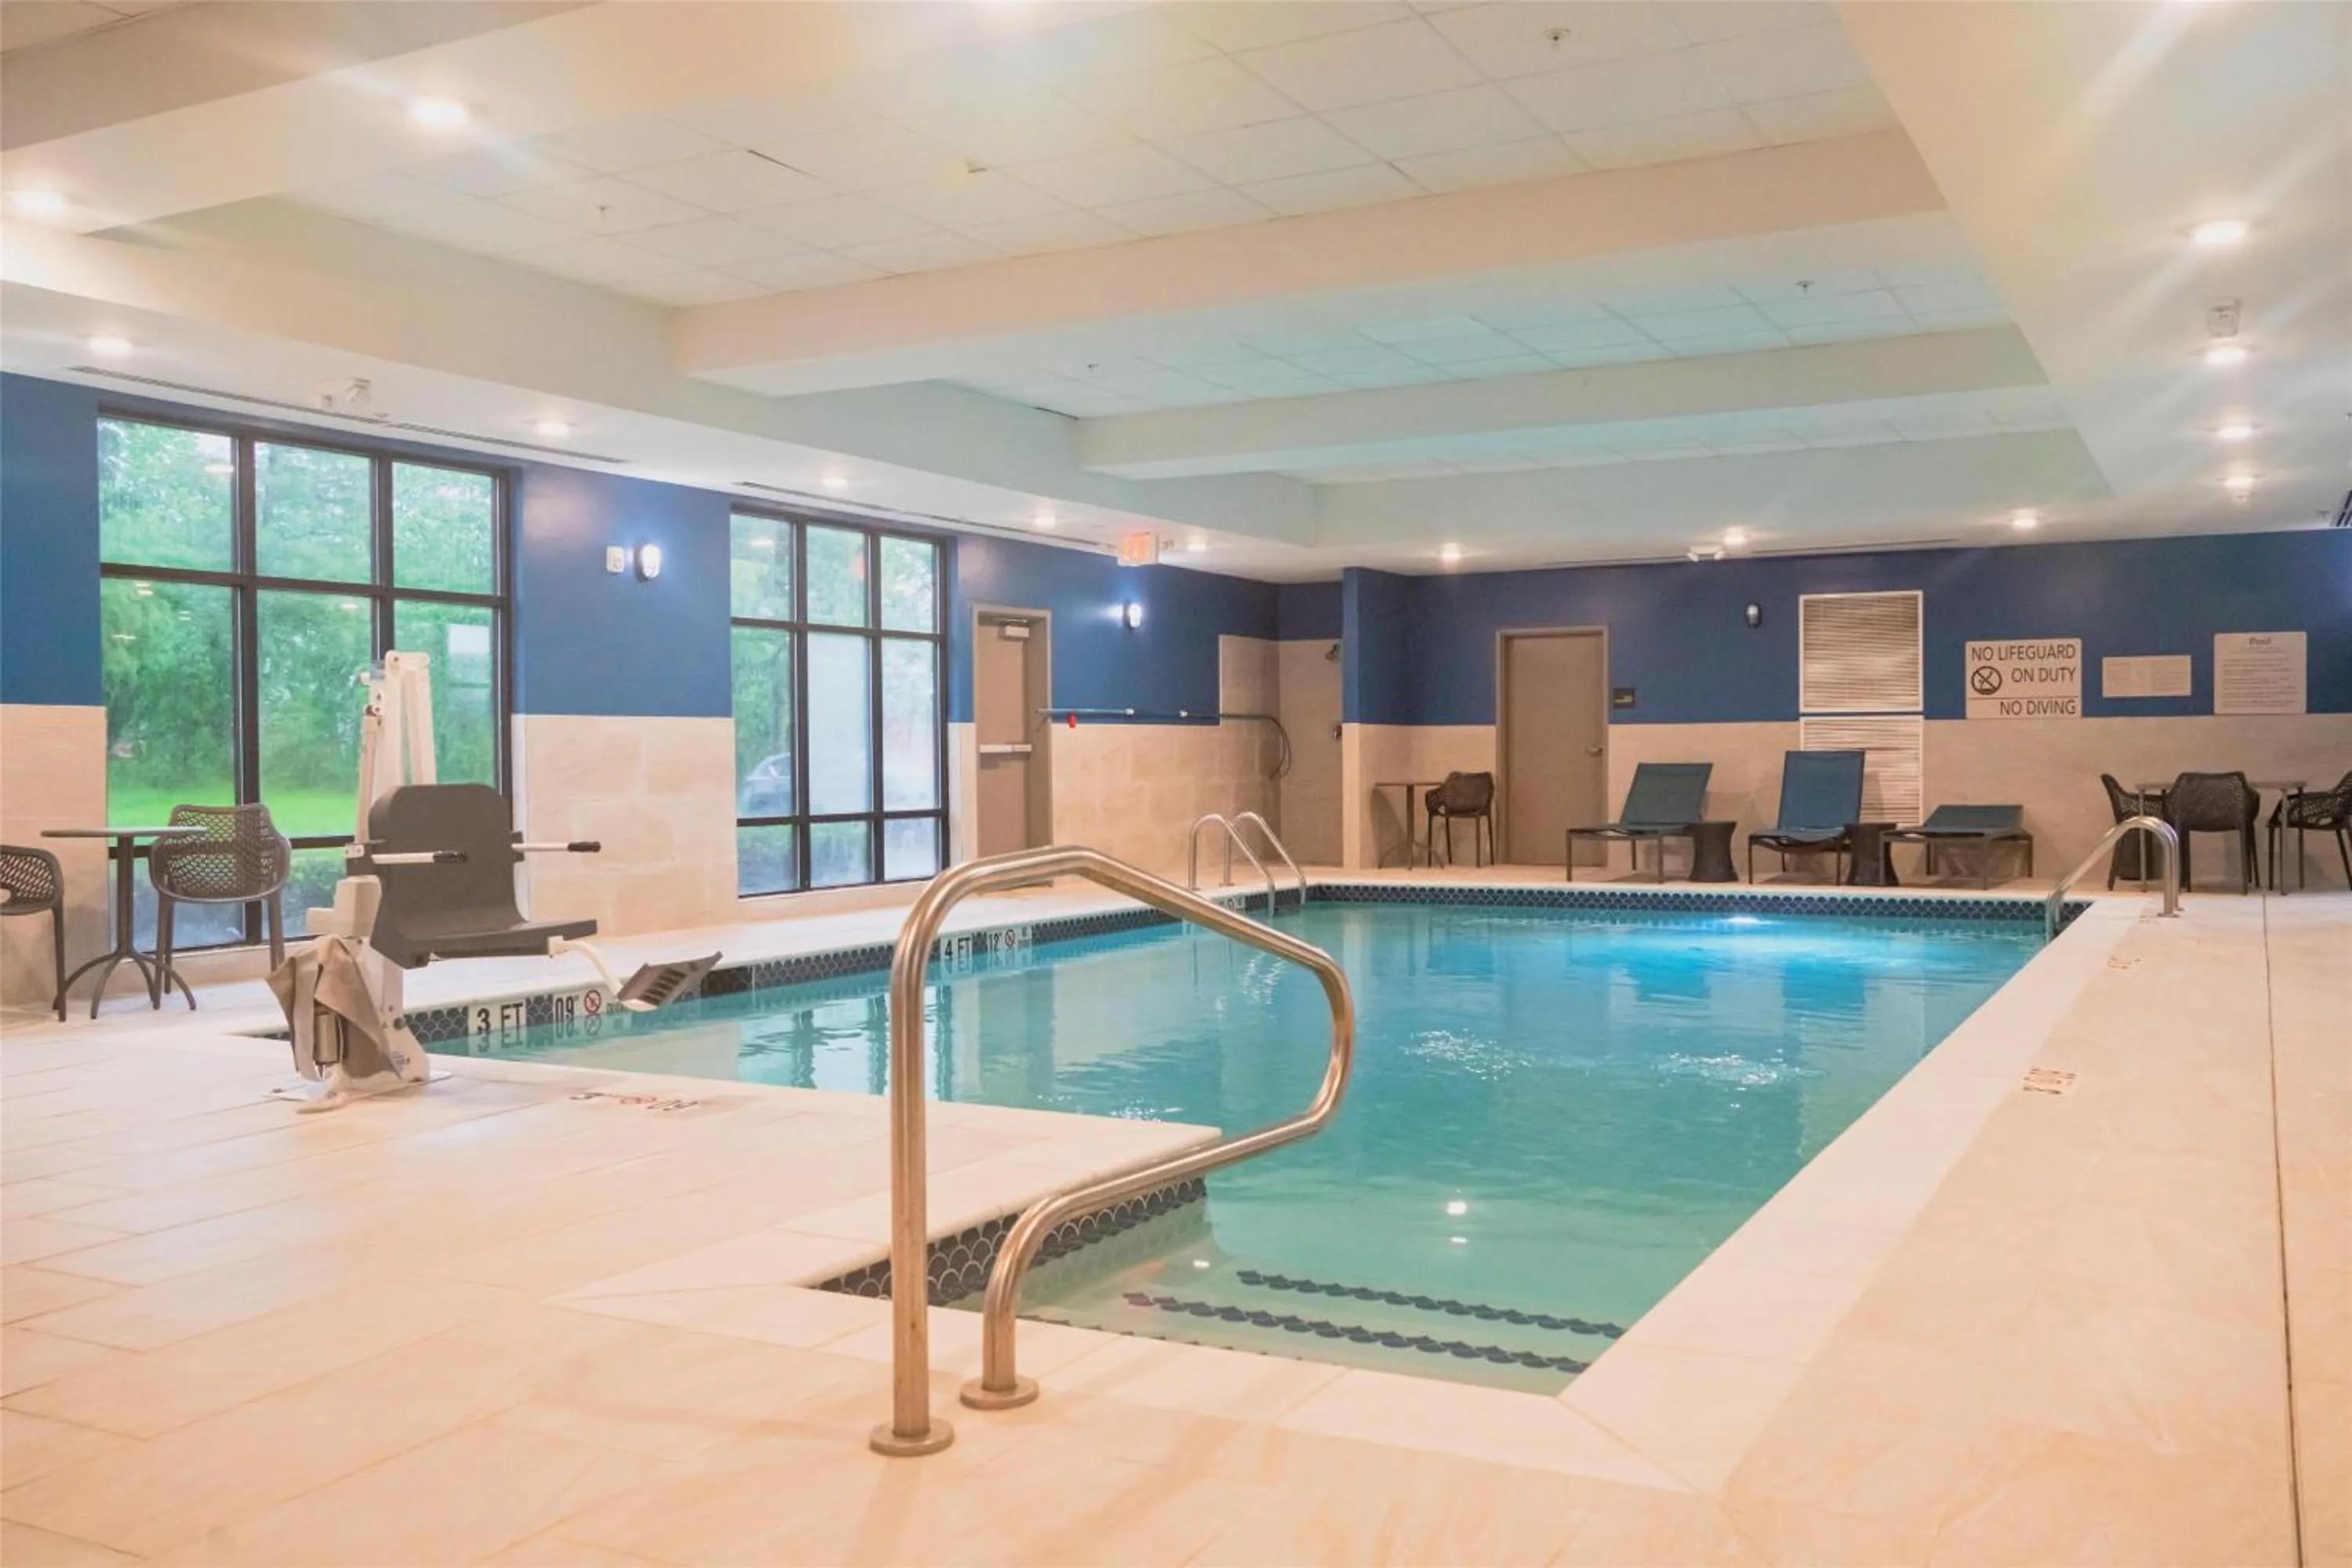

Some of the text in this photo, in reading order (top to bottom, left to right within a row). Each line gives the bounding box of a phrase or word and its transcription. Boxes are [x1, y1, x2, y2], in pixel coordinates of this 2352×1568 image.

[1972, 644, 2077, 661] NO LIFEGUARD
[2011, 666, 2077, 683] ON DUTY
[2000, 699, 2077, 715] NO DIVING
[945, 940, 953, 956] 4
[957, 937, 971, 955] FT
[476, 1007, 491, 1035] 3
[501, 1002, 524, 1029] FT
